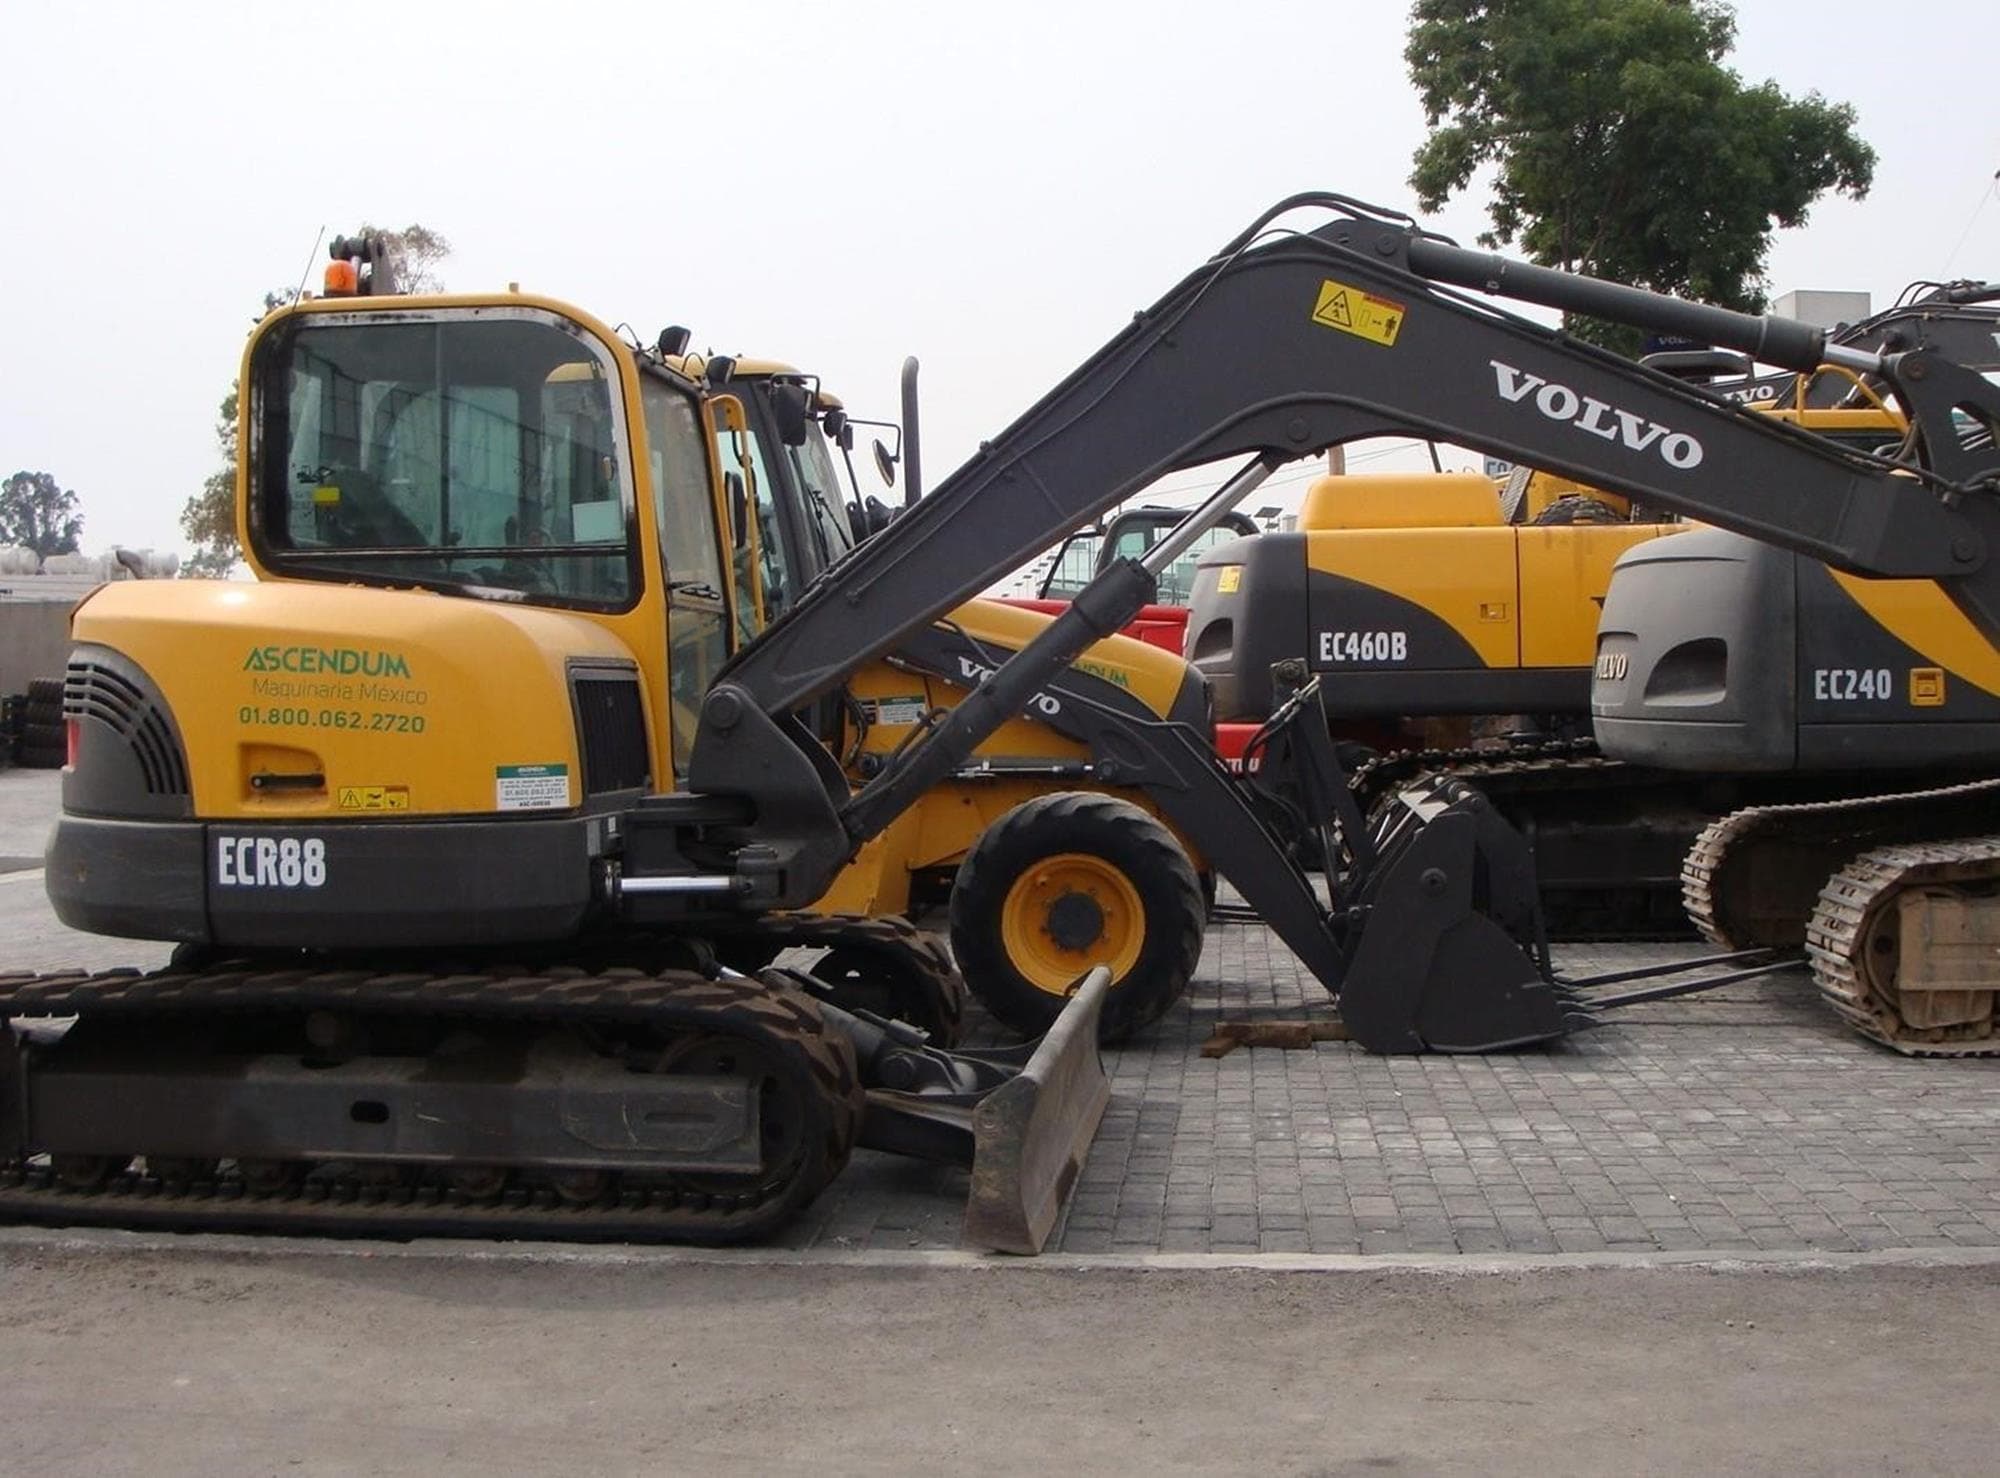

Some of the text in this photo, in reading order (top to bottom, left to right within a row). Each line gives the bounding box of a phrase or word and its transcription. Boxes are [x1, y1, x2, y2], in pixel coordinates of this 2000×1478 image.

[1489, 359, 1704, 470] VOLVO
[1320, 631, 1407, 661] EC460B
[243, 647, 411, 679] ASCENDUM
[252, 678, 354, 702] Maquinaria
[1815, 669, 1892, 700] EC240
[239, 706, 425, 733] 01.800.062.2720
[218, 837, 326, 886] ECR88
